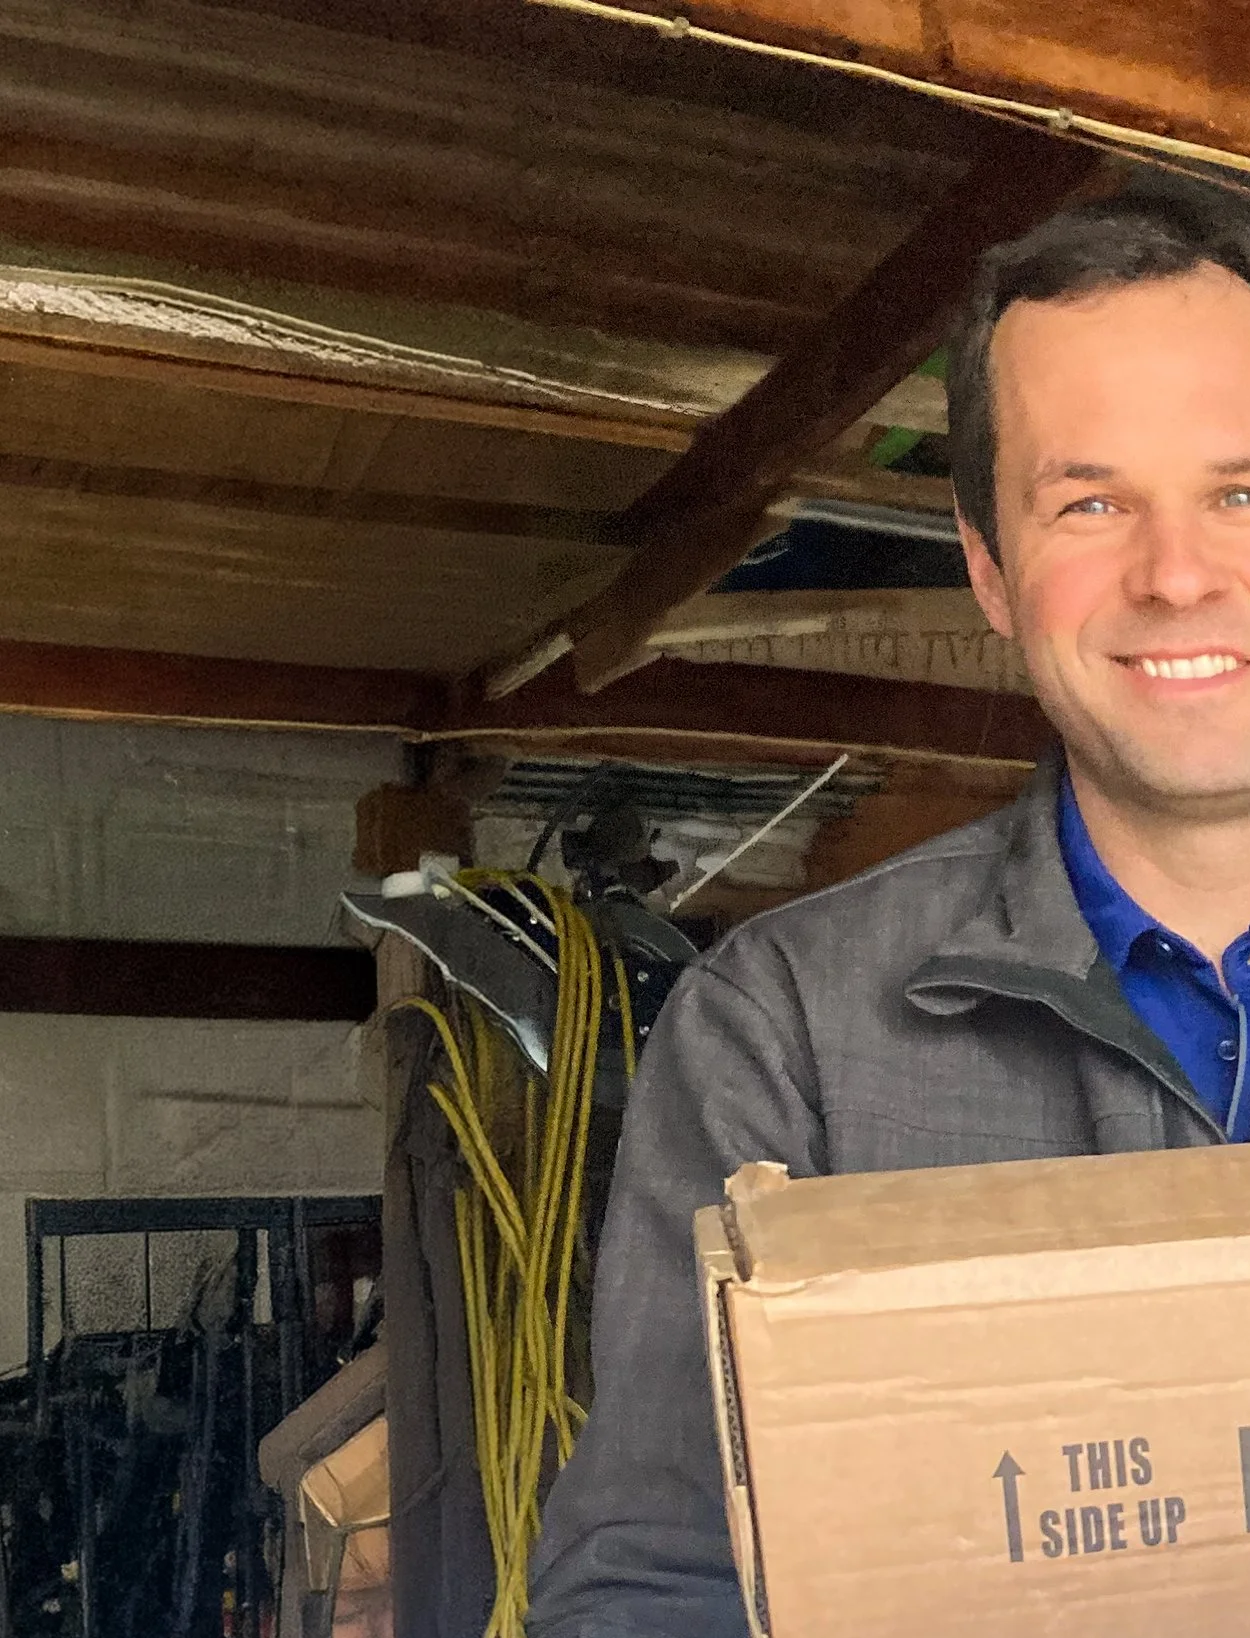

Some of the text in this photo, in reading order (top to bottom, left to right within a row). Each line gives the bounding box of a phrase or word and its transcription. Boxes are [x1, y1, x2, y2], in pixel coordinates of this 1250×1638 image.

[1062, 1437, 1152, 1492] THIS
[1041, 1498, 1186, 1555] SIDE UP
